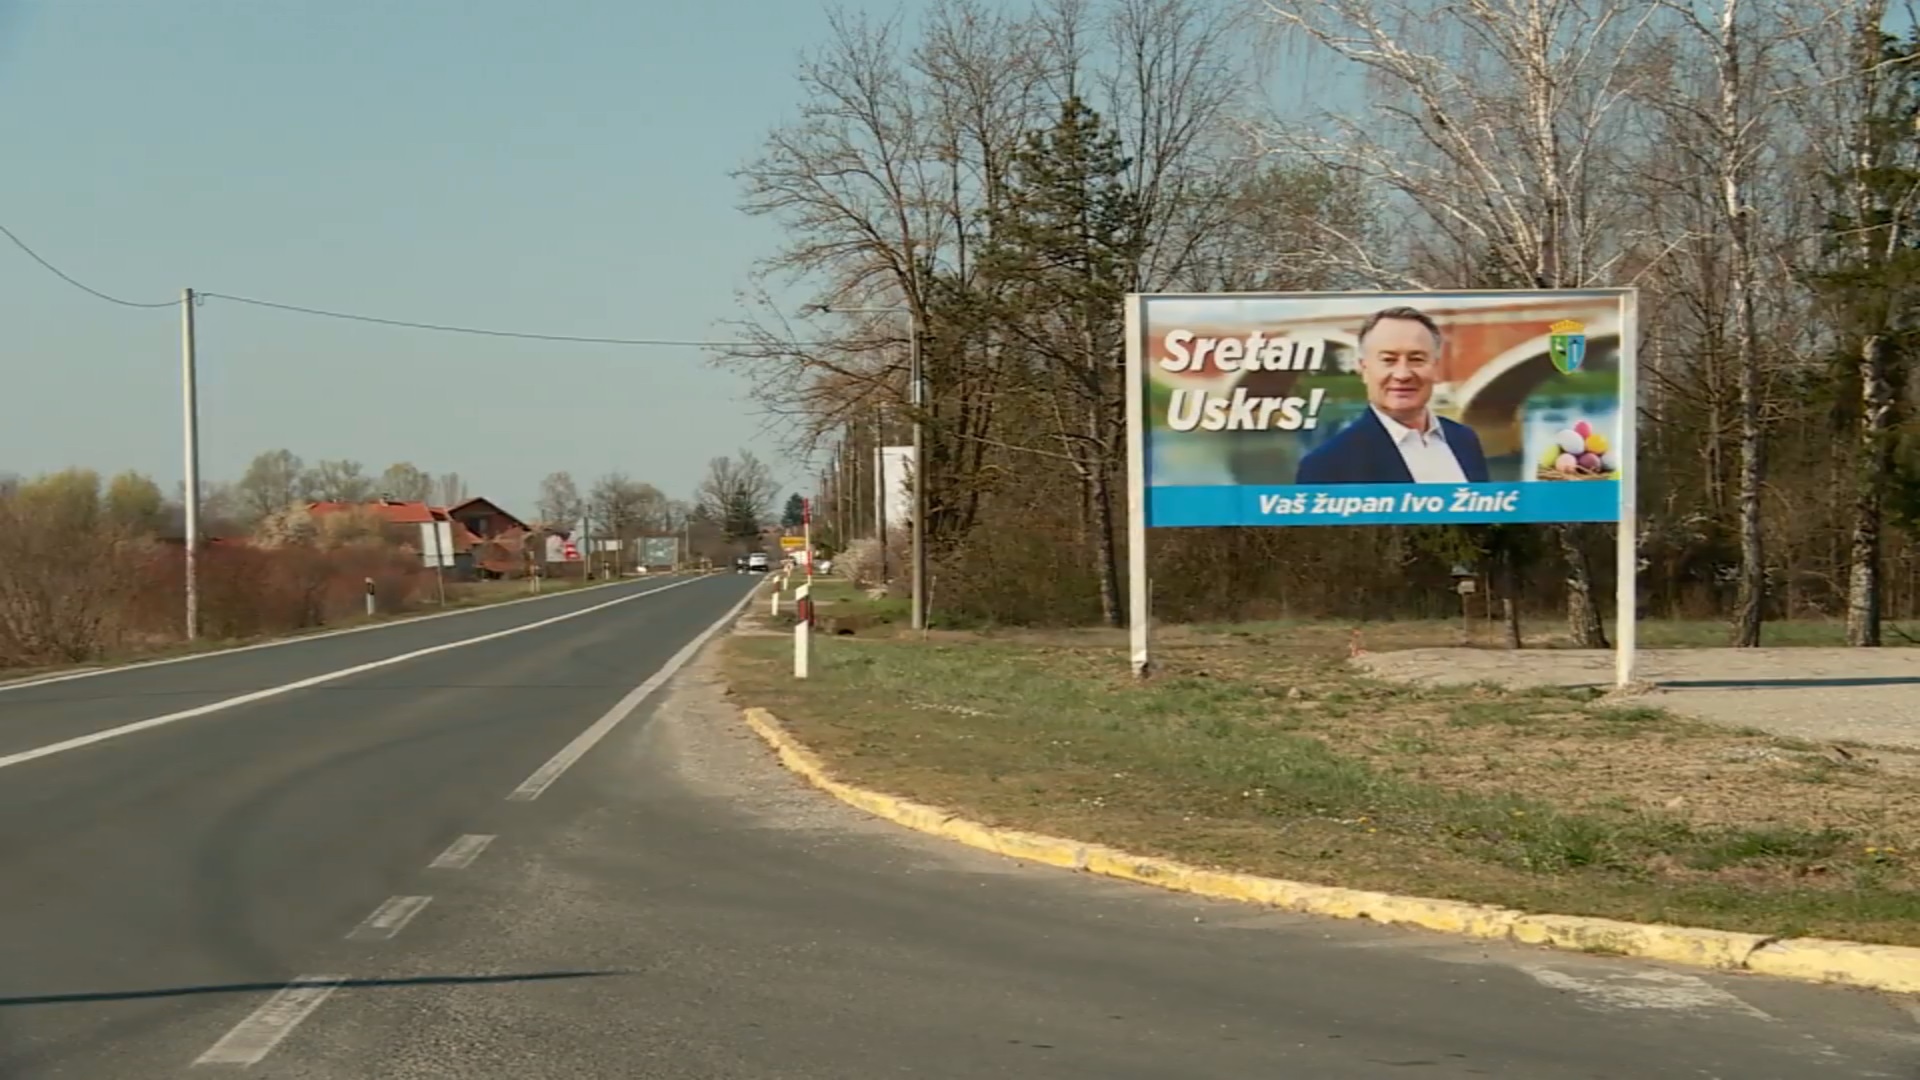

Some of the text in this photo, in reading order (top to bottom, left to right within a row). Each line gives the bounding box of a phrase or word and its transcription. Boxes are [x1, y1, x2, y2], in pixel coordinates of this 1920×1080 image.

[1160, 329, 1325, 373] Sretan
[1167, 388, 1325, 432] Uskrs!
[1259, 488, 1520, 517] Vaš župan Ivo Žinić
